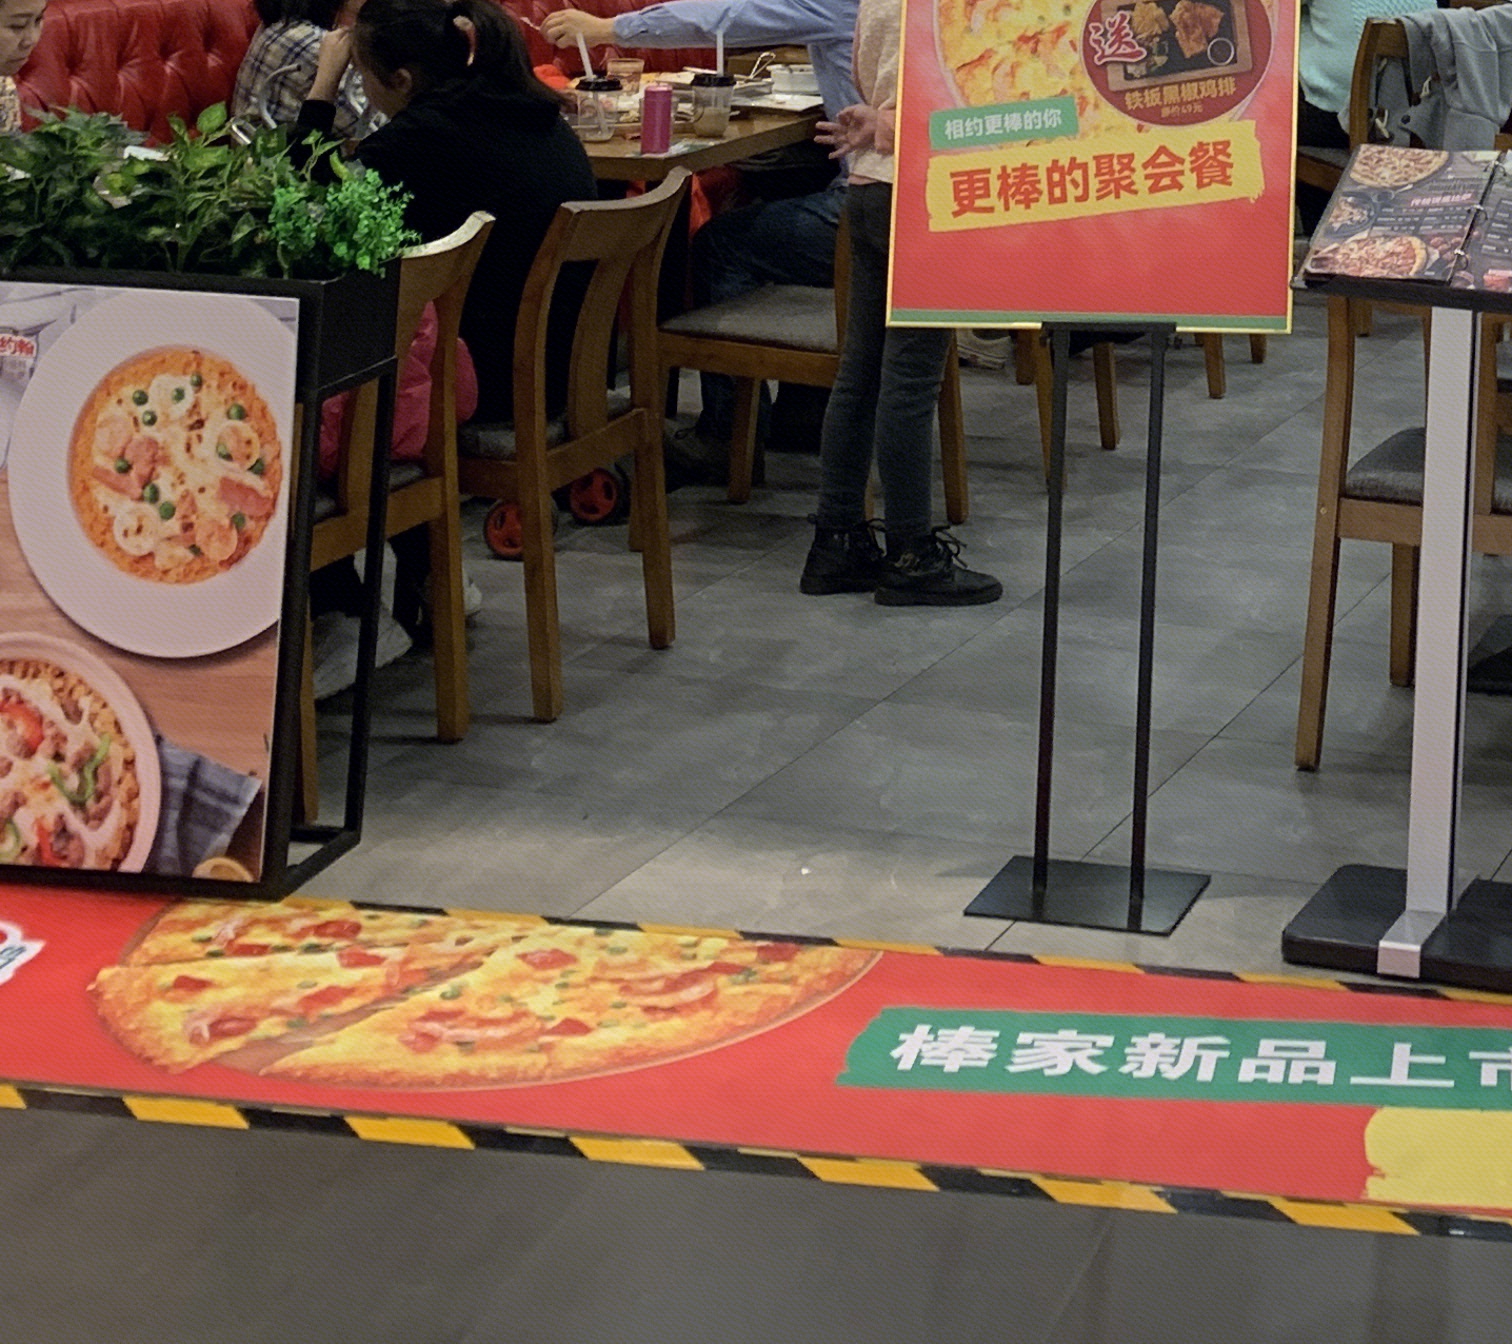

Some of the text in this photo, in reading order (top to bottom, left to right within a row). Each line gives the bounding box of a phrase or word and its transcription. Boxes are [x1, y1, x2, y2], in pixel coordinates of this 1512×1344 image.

[1088, 10, 1148, 66] 送
[944, 107, 1063, 141] 相约更棒的你
[949, 139, 1235, 219] 更棒的聚会餐
